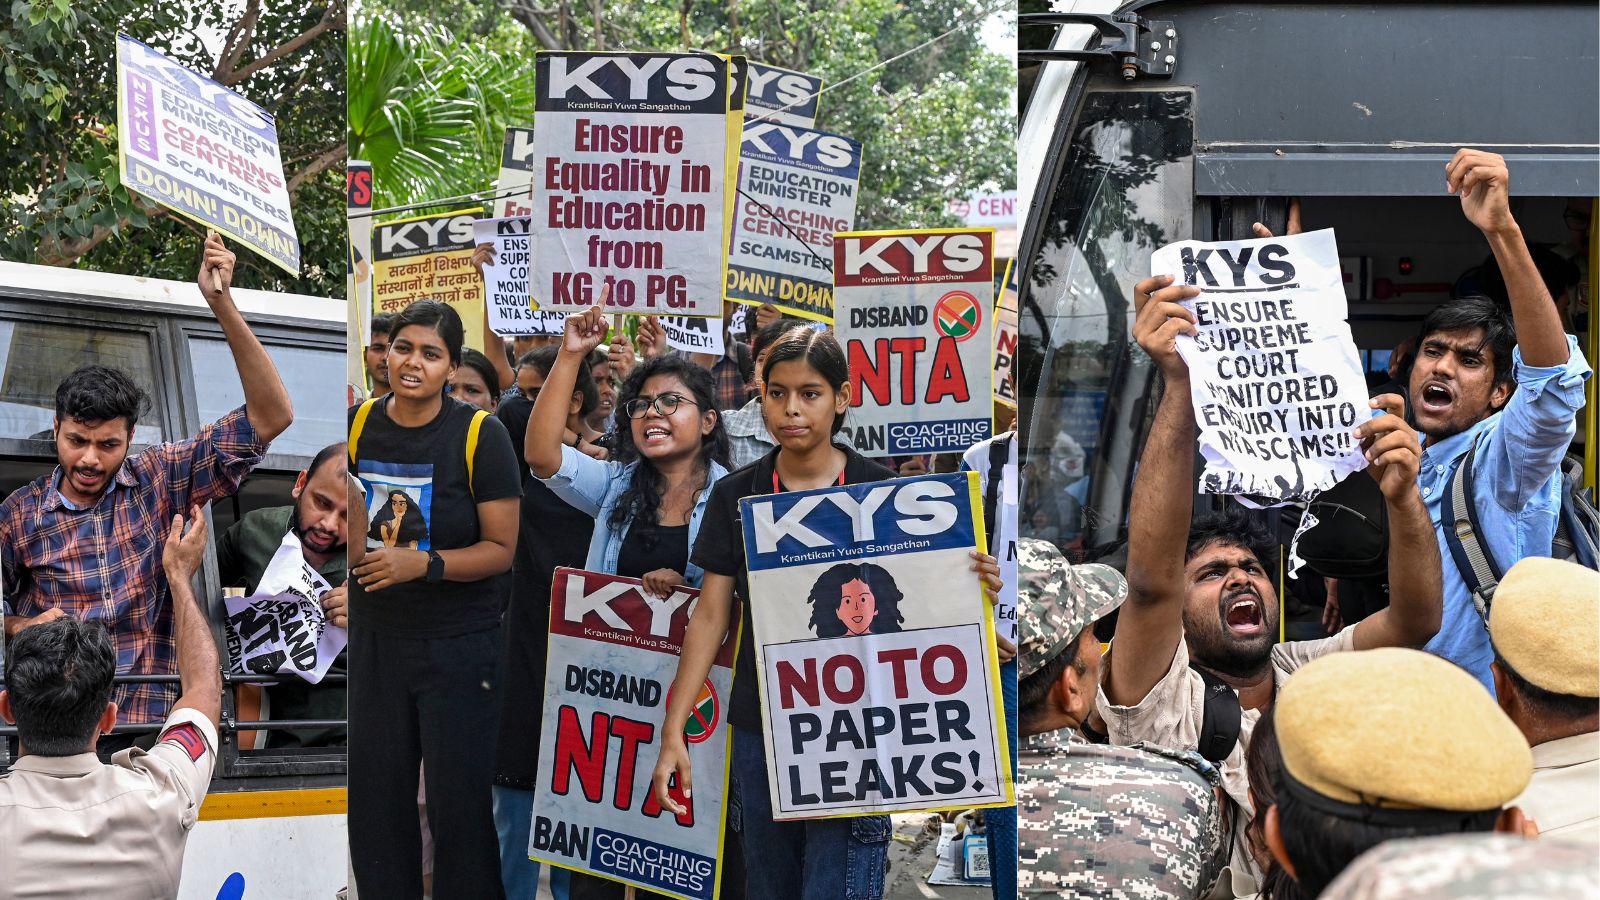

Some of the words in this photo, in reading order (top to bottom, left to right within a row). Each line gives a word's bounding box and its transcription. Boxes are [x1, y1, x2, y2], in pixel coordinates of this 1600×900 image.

[130, 40, 267, 130] KYS
[549, 56, 716, 102] KYS
[133, 80, 151, 151] NEXUS
[161, 89, 276, 157] EDUCATION
[567, 101, 613, 109] Krantikari
[614, 102, 638, 110] Yuva
[639, 102, 691, 112] Sangathan
[162, 102, 257, 158] MINISTER
[575, 119, 683, 154] Ensure
[162, 119, 282, 188] COACHING
[164, 132, 271, 194] CENTRES
[166, 153, 289, 222] SCAMSTERS
[545, 157, 670, 196] Equality
[681, 159, 711, 193] in
[748, 179, 831, 207] MINISTER
[750, 165, 852, 197] EDUCATION
[136, 164, 218, 219] DOWN!
[223, 204, 295, 259] DOWN!
[548, 195, 706, 232] Education
[745, 201, 849, 232] COACHING
[978, 198, 1017, 216] CEN
[381, 215, 476, 253] KYS
[503, 239, 530, 251] ENS
[743, 217, 834, 247] CENTRES
[388, 257, 432, 278] सरकारी
[434, 256, 473, 271] शिक्षण
[587, 235, 663, 269] from
[845, 234, 984, 276] KYS
[1180, 243, 1296, 288] KYS
[377, 275, 423, 295] संस्थानों
[424, 273, 436, 288] में
[510, 267, 529, 279] CO
[552, 271, 593, 306] KG
[604, 274, 636, 307] to
[646, 274, 696, 309] PG.
[861, 275, 900, 283] Krantikari
[921, 274, 964, 282] Sangathan
[463, 285, 480, 300] को
[499, 307, 522, 320] NTA
[850, 305, 928, 329] DISBAND
[1195, 299, 1297, 326] ENSURE
[1193, 322, 1313, 353] SUPREME
[847, 336, 970, 408] NTA
[1217, 349, 1300, 381] COURT
[890, 421, 989, 437] COACHING
[1297, 402, 1356, 432] INTO
[896, 433, 983, 449] CENTRES
[752, 480, 959, 555] KYS
[781, 549, 835, 564] Krantikari
[837, 547, 864, 557] Yuva
[866, 540, 931, 553] Sangathan
[564, 574, 729, 645] KY
[250, 600, 317, 672] DISBAND
[584, 627, 632, 642] Krantikari
[635, 636, 656, 647] Yuva
[565, 664, 662, 707] DISBAND
[776, 654, 866, 710] NO
[877, 644, 968, 700] TO
[788, 699, 976, 755] PAPER
[788, 749, 986, 806] LEAKS!
[533, 815, 590, 861] BAN
[596, 833, 712, 877] COACHING
[600, 849, 704, 893] CENTRES
